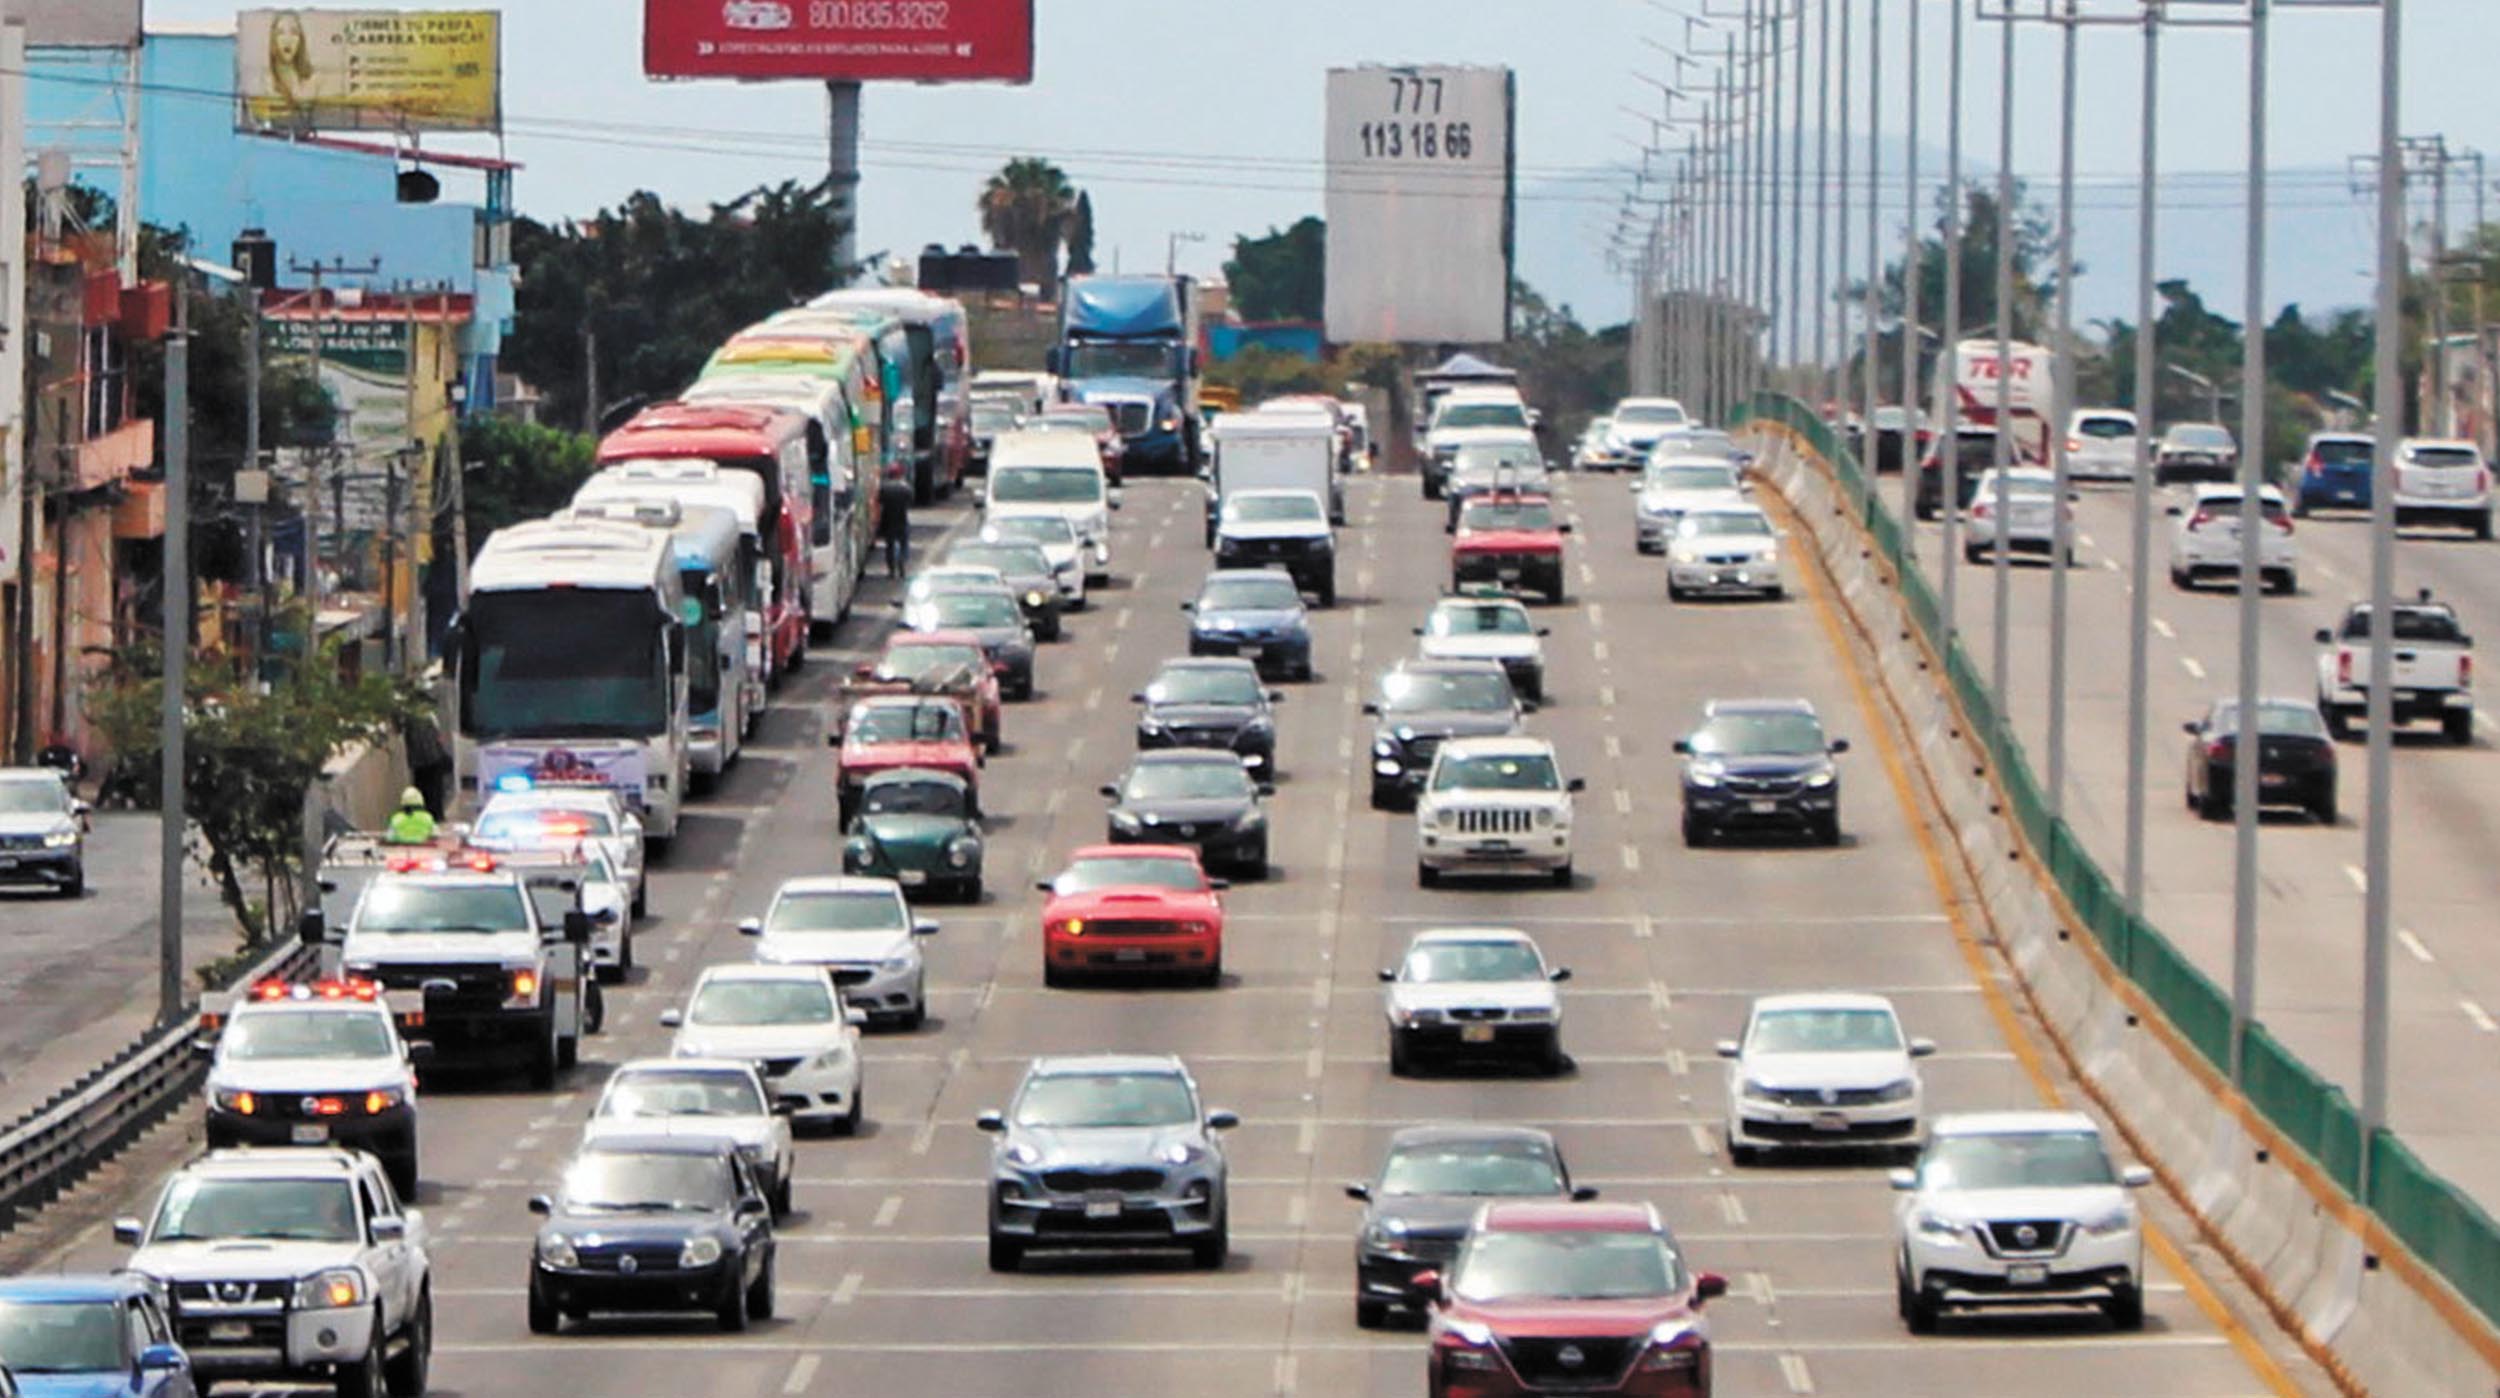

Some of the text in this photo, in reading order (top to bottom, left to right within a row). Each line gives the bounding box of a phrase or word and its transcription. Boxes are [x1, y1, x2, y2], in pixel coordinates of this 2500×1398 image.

[809, 0, 950, 29] 800.835.3262
[1389, 77, 1442, 113] 777
[1361, 121, 1471, 158] 113 18 66
